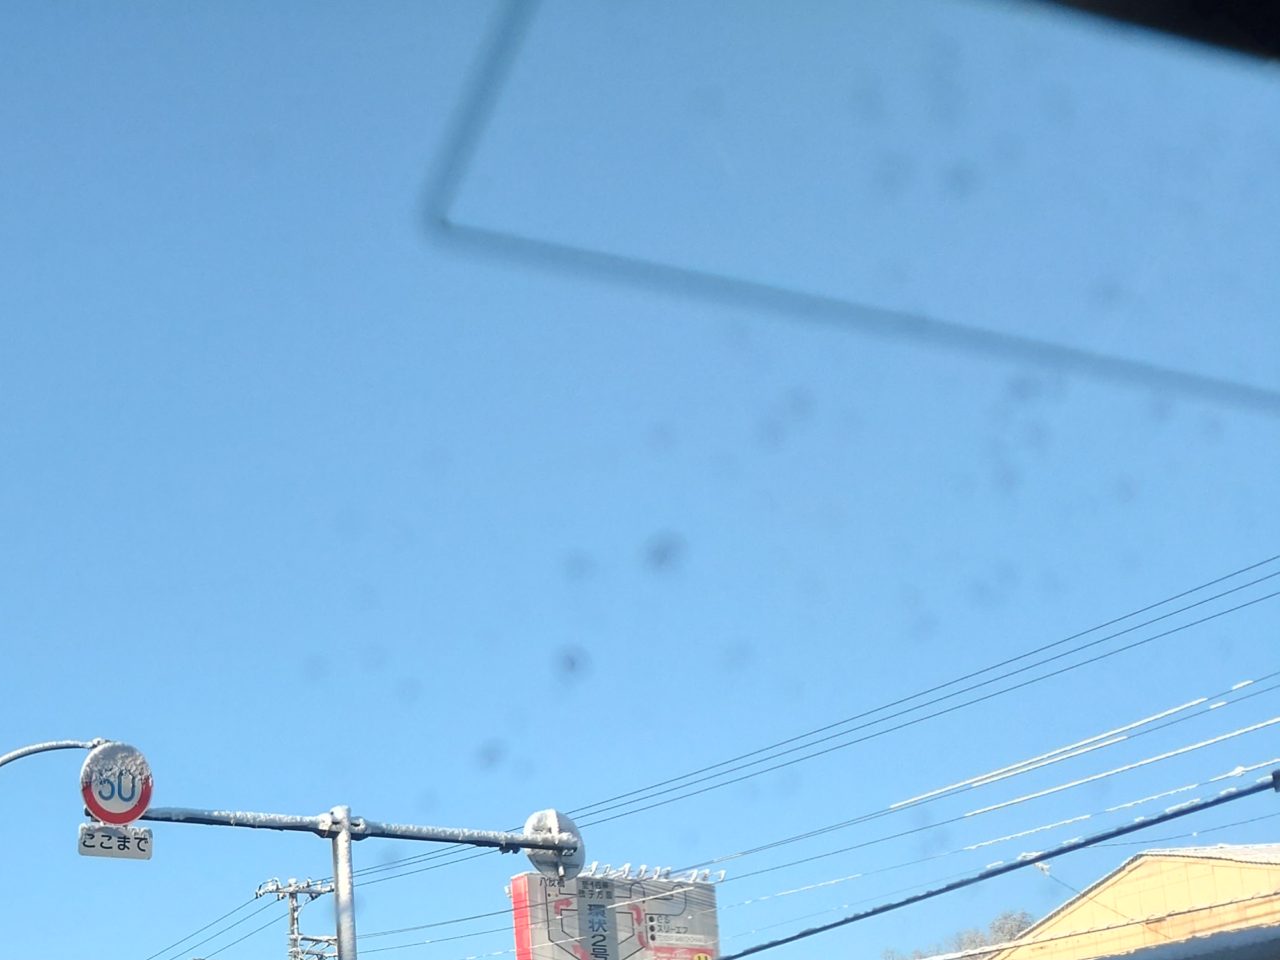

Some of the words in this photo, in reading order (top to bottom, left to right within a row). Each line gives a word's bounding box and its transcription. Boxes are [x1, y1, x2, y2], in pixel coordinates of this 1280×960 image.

[98, 768, 136, 802] 50
[83, 833, 148, 852] ここまで
